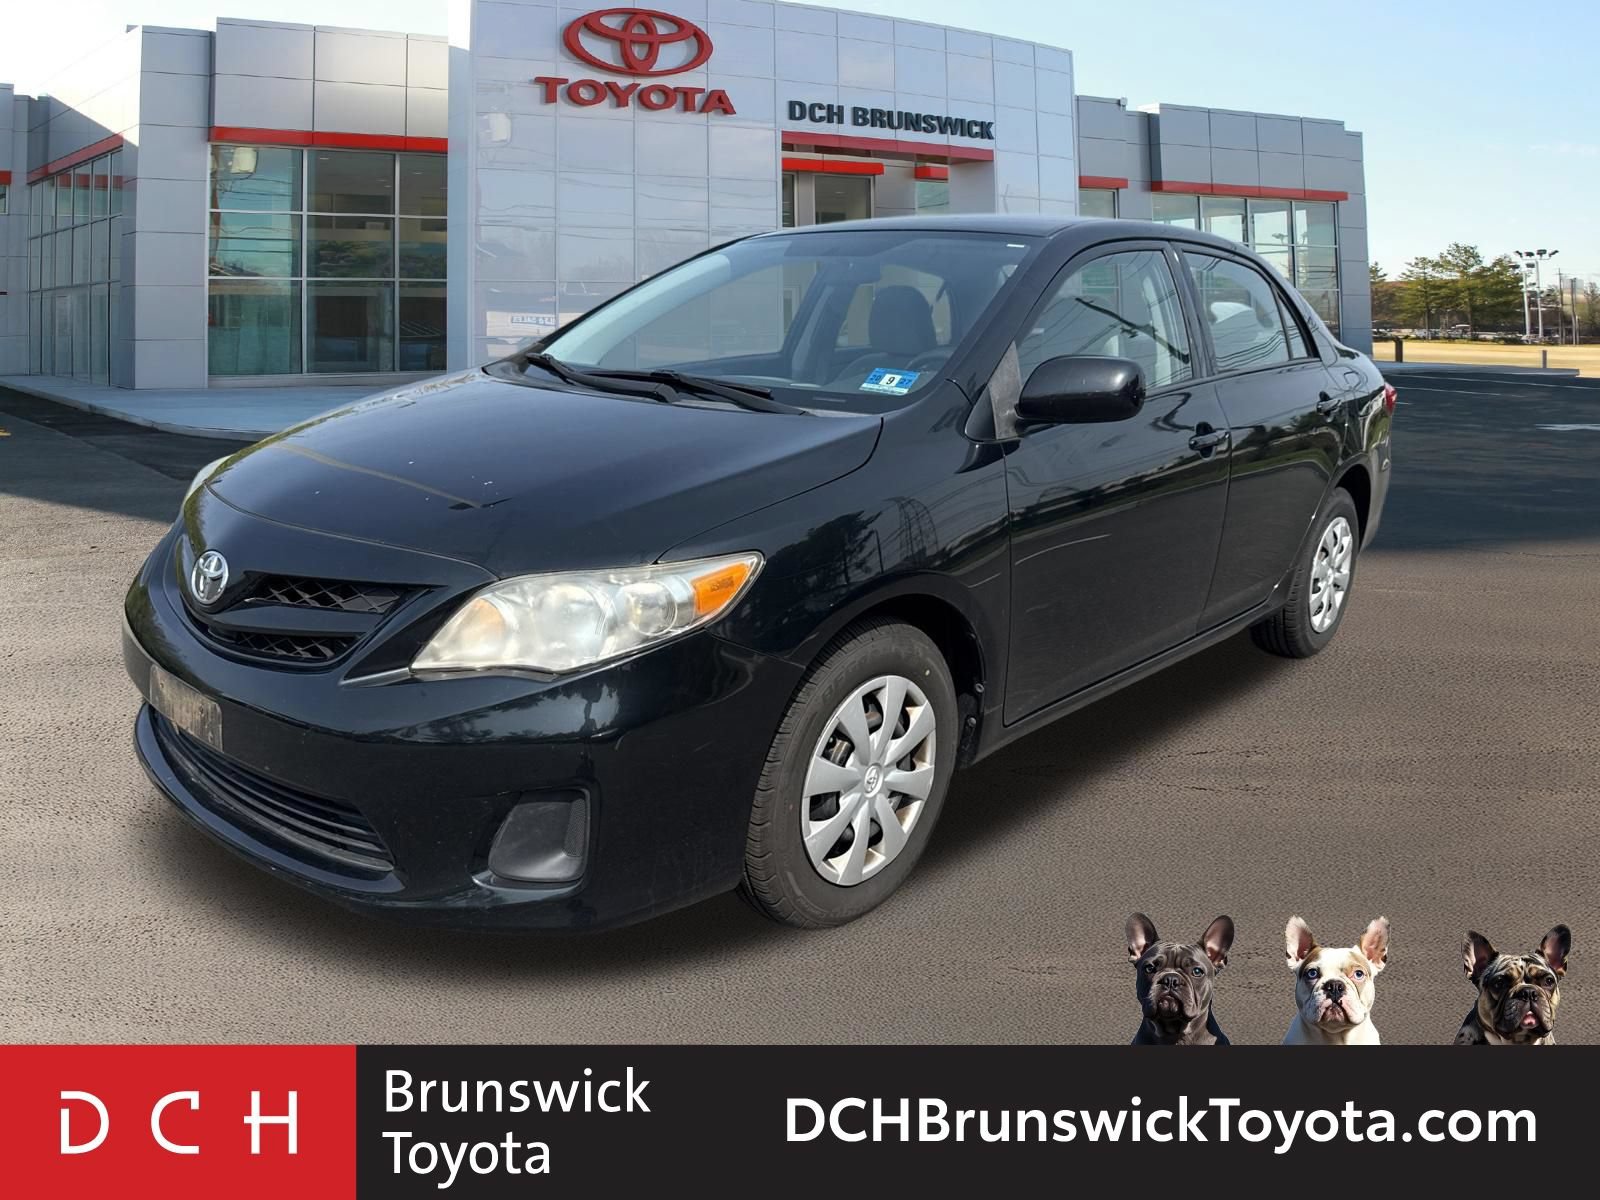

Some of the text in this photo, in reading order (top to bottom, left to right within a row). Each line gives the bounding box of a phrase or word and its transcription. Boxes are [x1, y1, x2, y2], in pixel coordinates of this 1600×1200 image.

[534, 77, 737, 115] TOYOTA
[788, 100, 995, 140] DCH BRUNSWICK
[886, 376, 896, 385] 9
